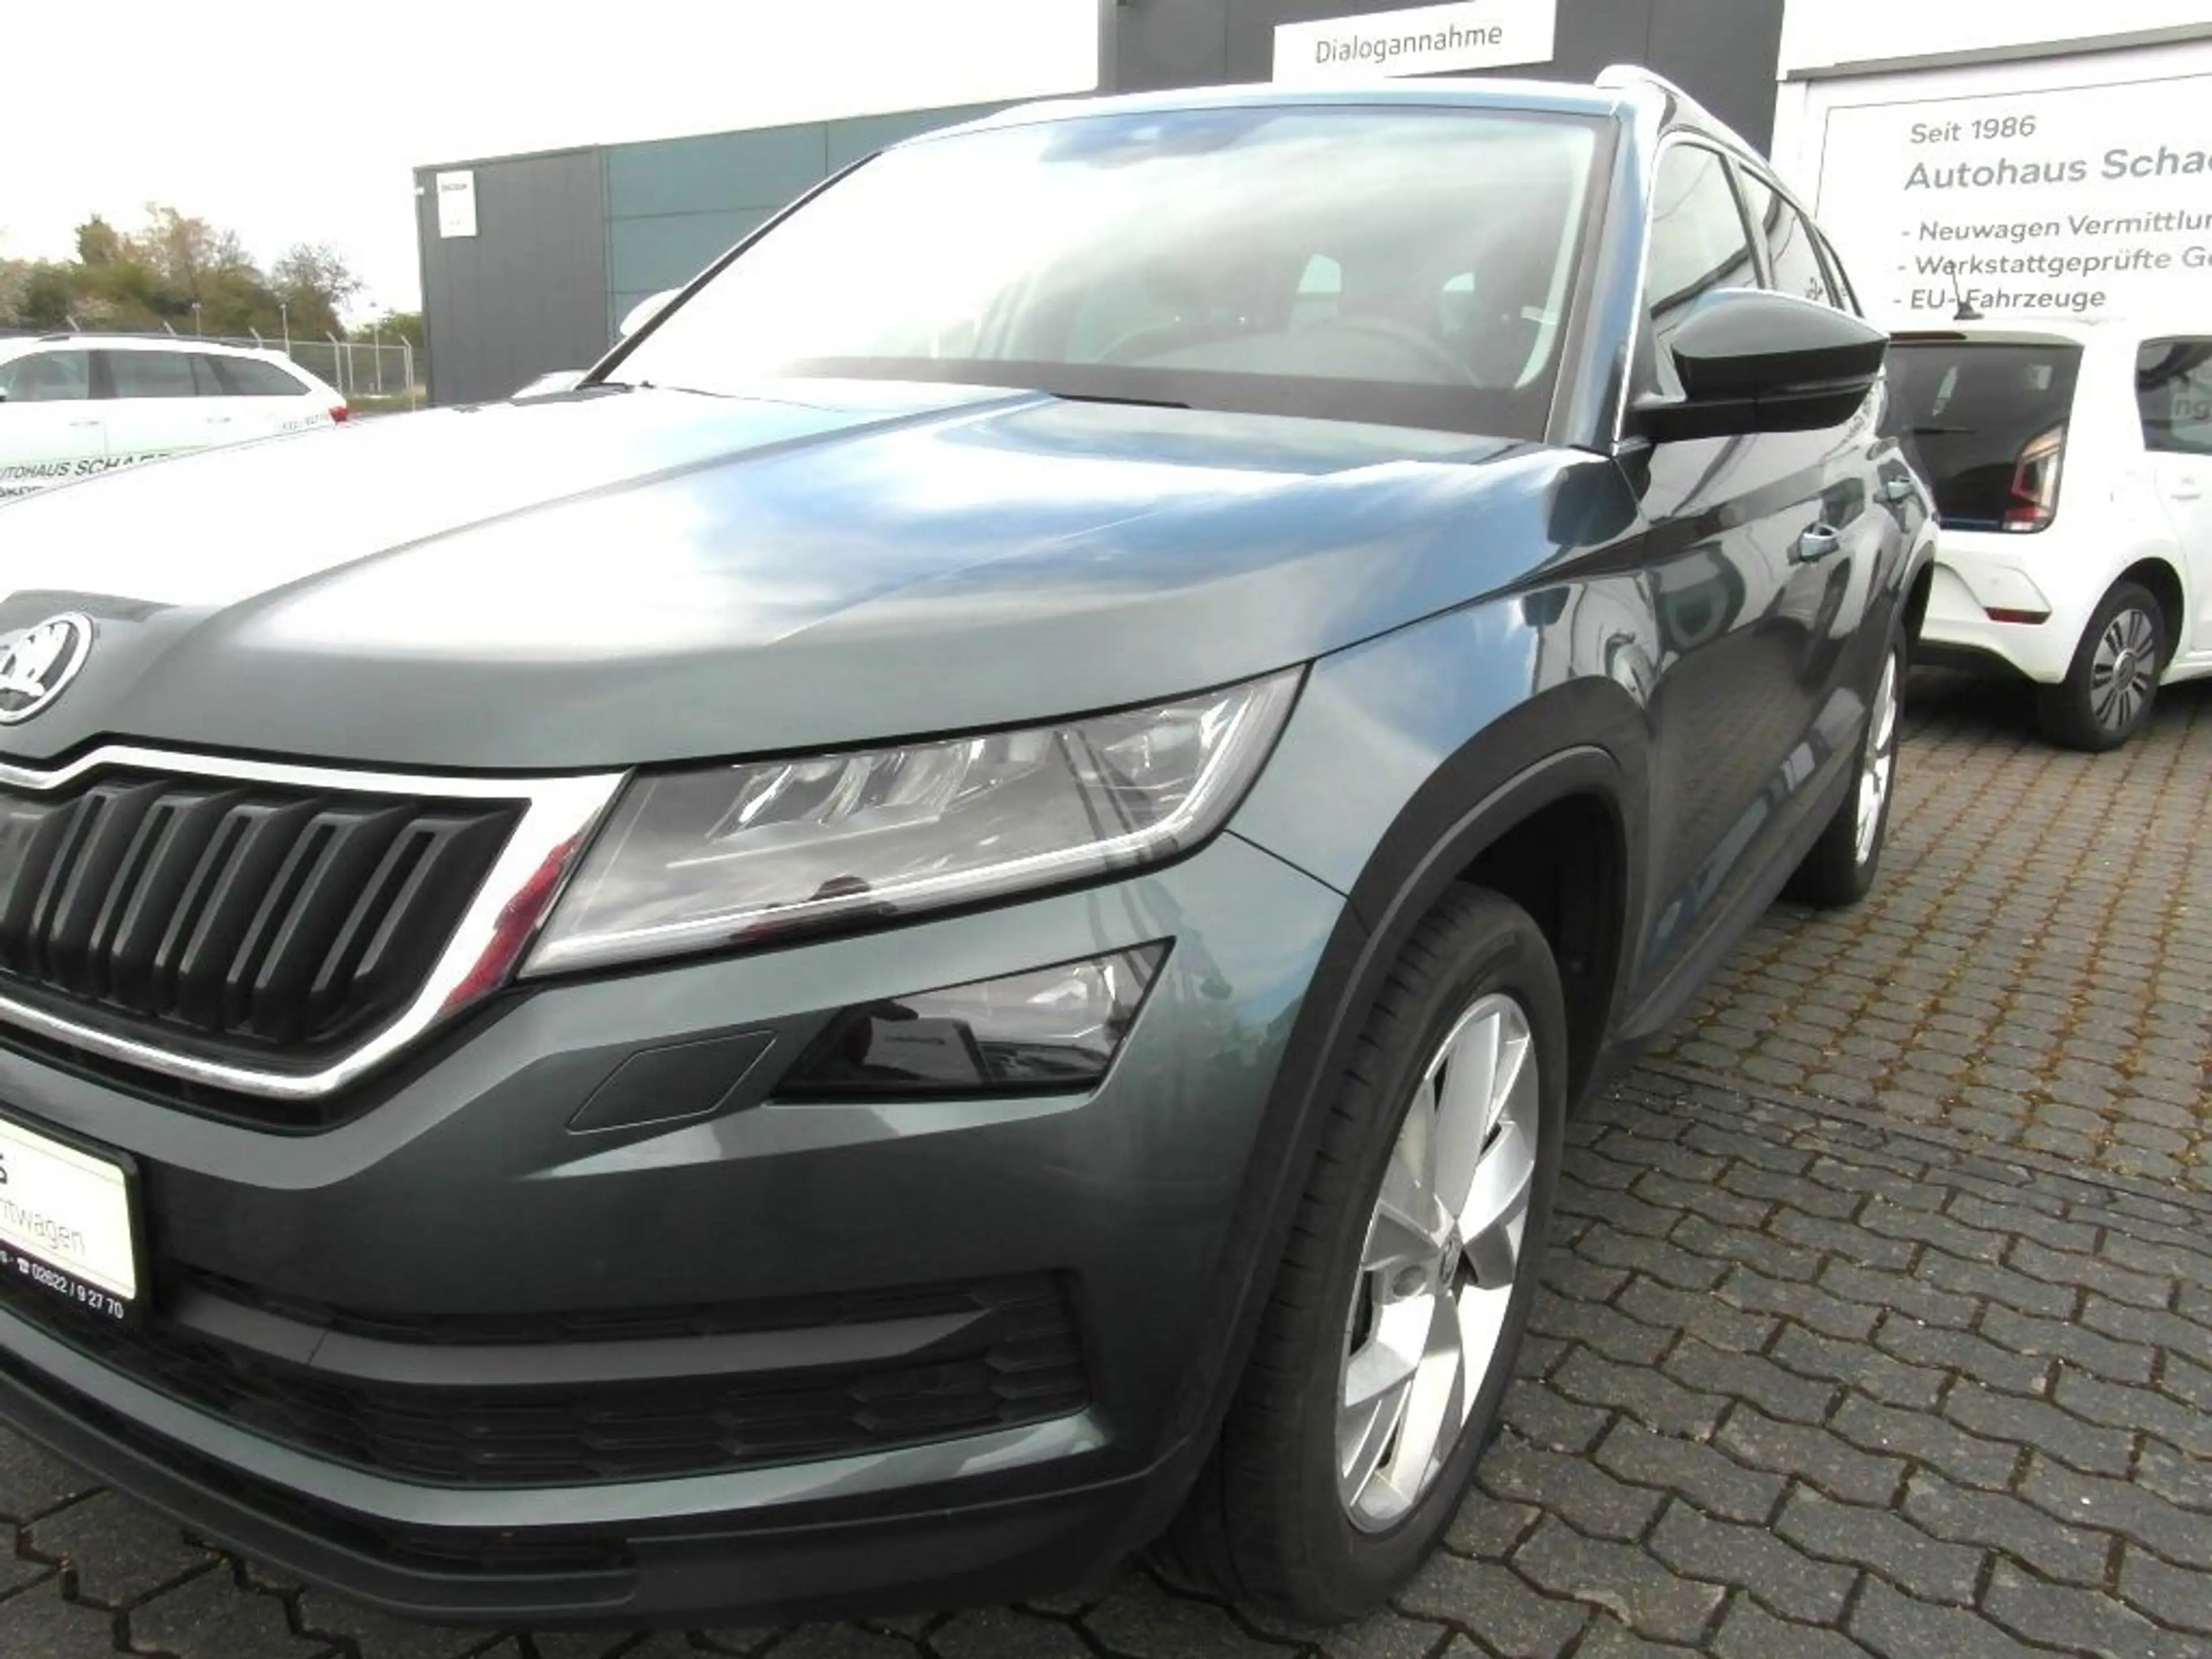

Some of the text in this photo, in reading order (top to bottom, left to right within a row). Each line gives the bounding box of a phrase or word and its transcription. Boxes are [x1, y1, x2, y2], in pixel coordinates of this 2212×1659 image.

[1315, 25, 1502, 64] Dialogannahme
[1910, 115, 2036, 144] Seit 1986
[1903, 157, 2087, 191] Autohaus
[1919, 221, 2060, 244] Neuwagen
[1915, 248, 2172, 278] Werkstattgeprüfte
[2181, 245, 2212, 268] G
